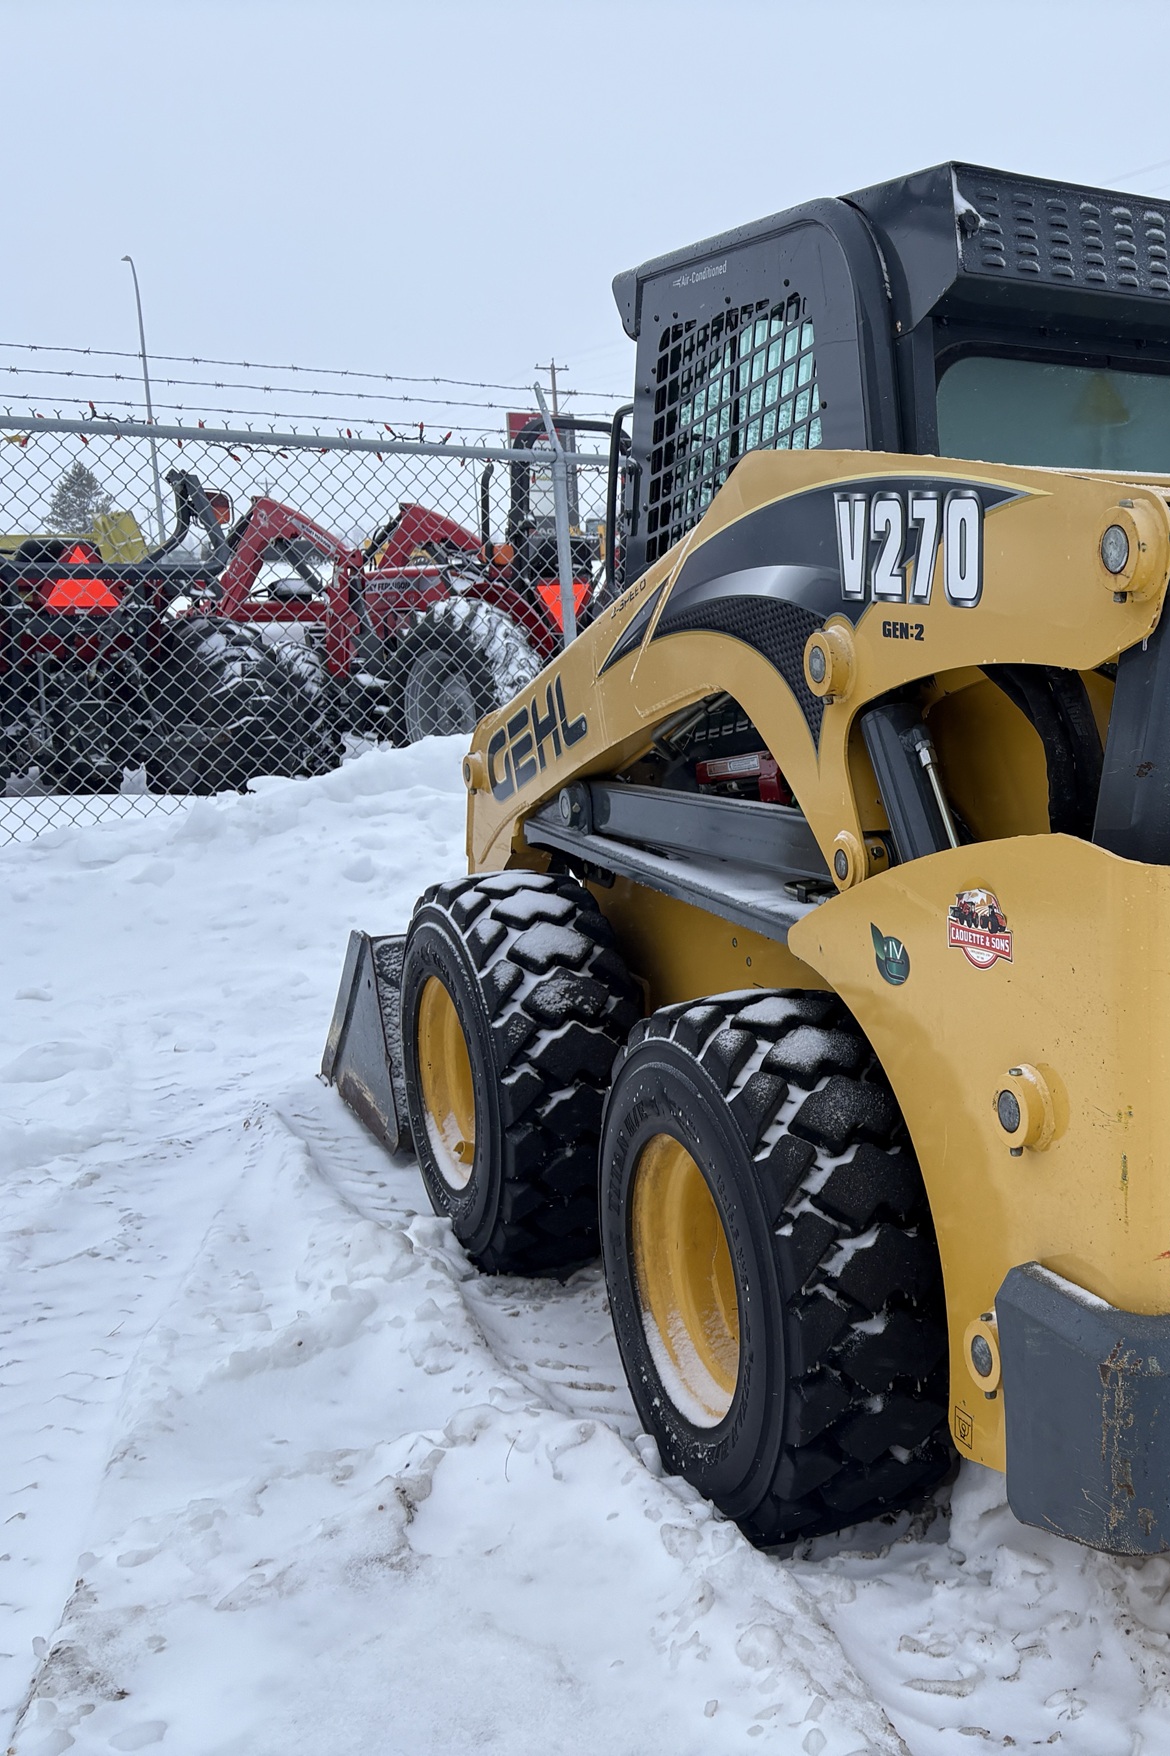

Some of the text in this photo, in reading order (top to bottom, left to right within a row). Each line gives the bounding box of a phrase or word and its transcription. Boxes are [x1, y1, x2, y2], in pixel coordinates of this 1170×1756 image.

[681, 260, 727, 286] Air-Conditioned
[833, 488, 985, 608] V270
[882, 620, 925, 641] GEN:2
[488, 671, 588, 803] GEHL
[991, 937, 1009, 952] SONS
